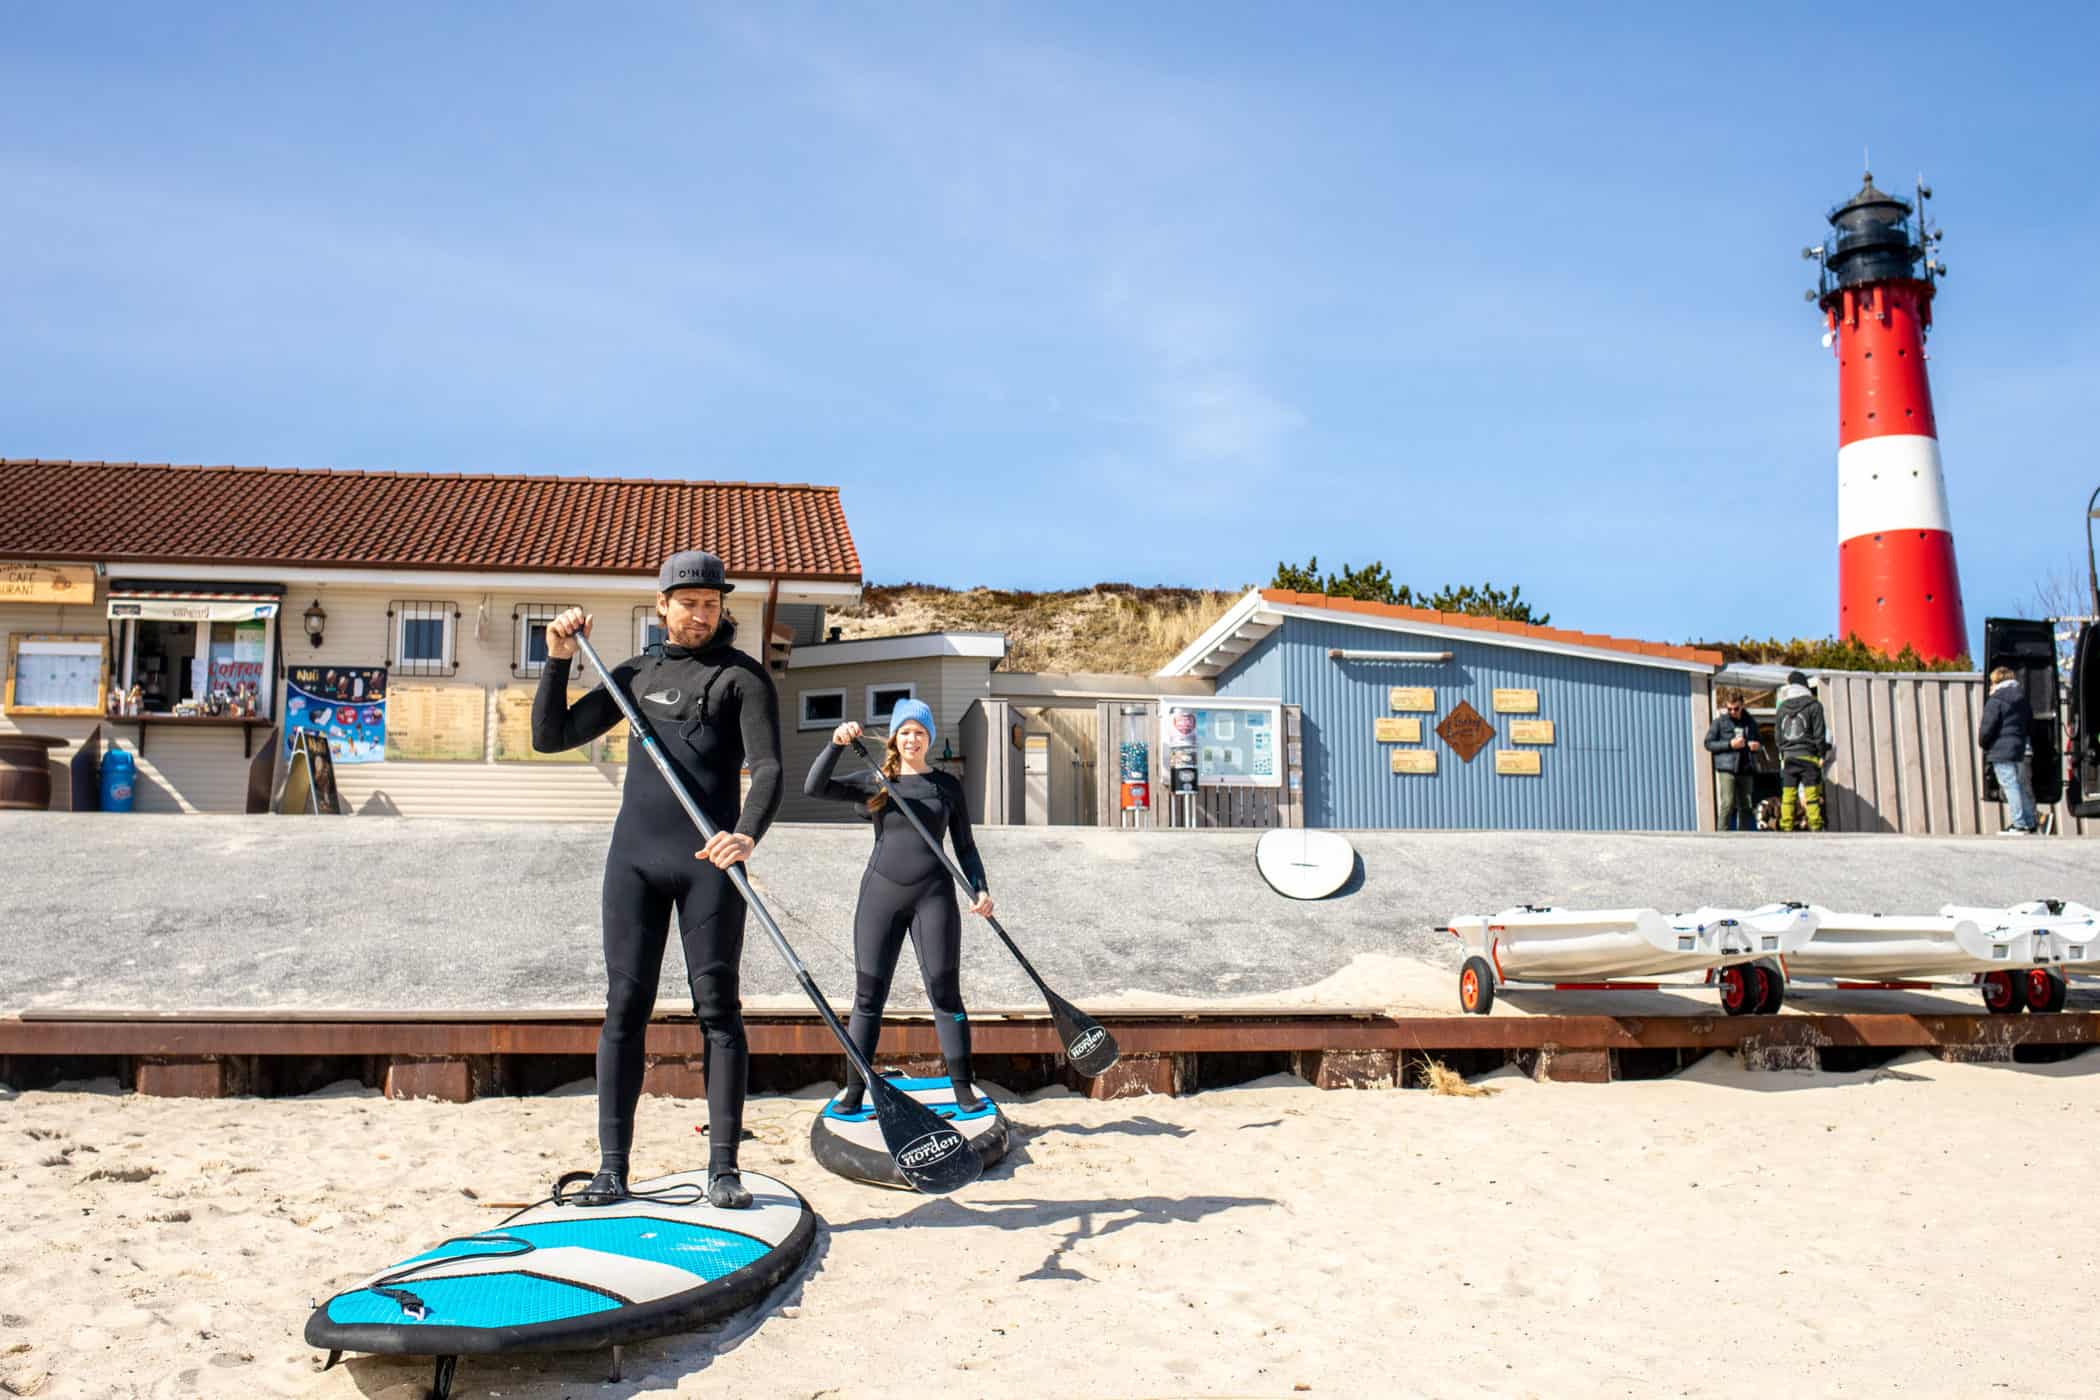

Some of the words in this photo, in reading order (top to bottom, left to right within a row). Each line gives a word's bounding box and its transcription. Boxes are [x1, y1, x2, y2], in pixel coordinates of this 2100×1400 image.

[679, 569, 720, 578] O'NE
[208, 661, 264, 678] Coffee
[1070, 1029, 1104, 1058] norden
[902, 1135, 959, 1166] norden
